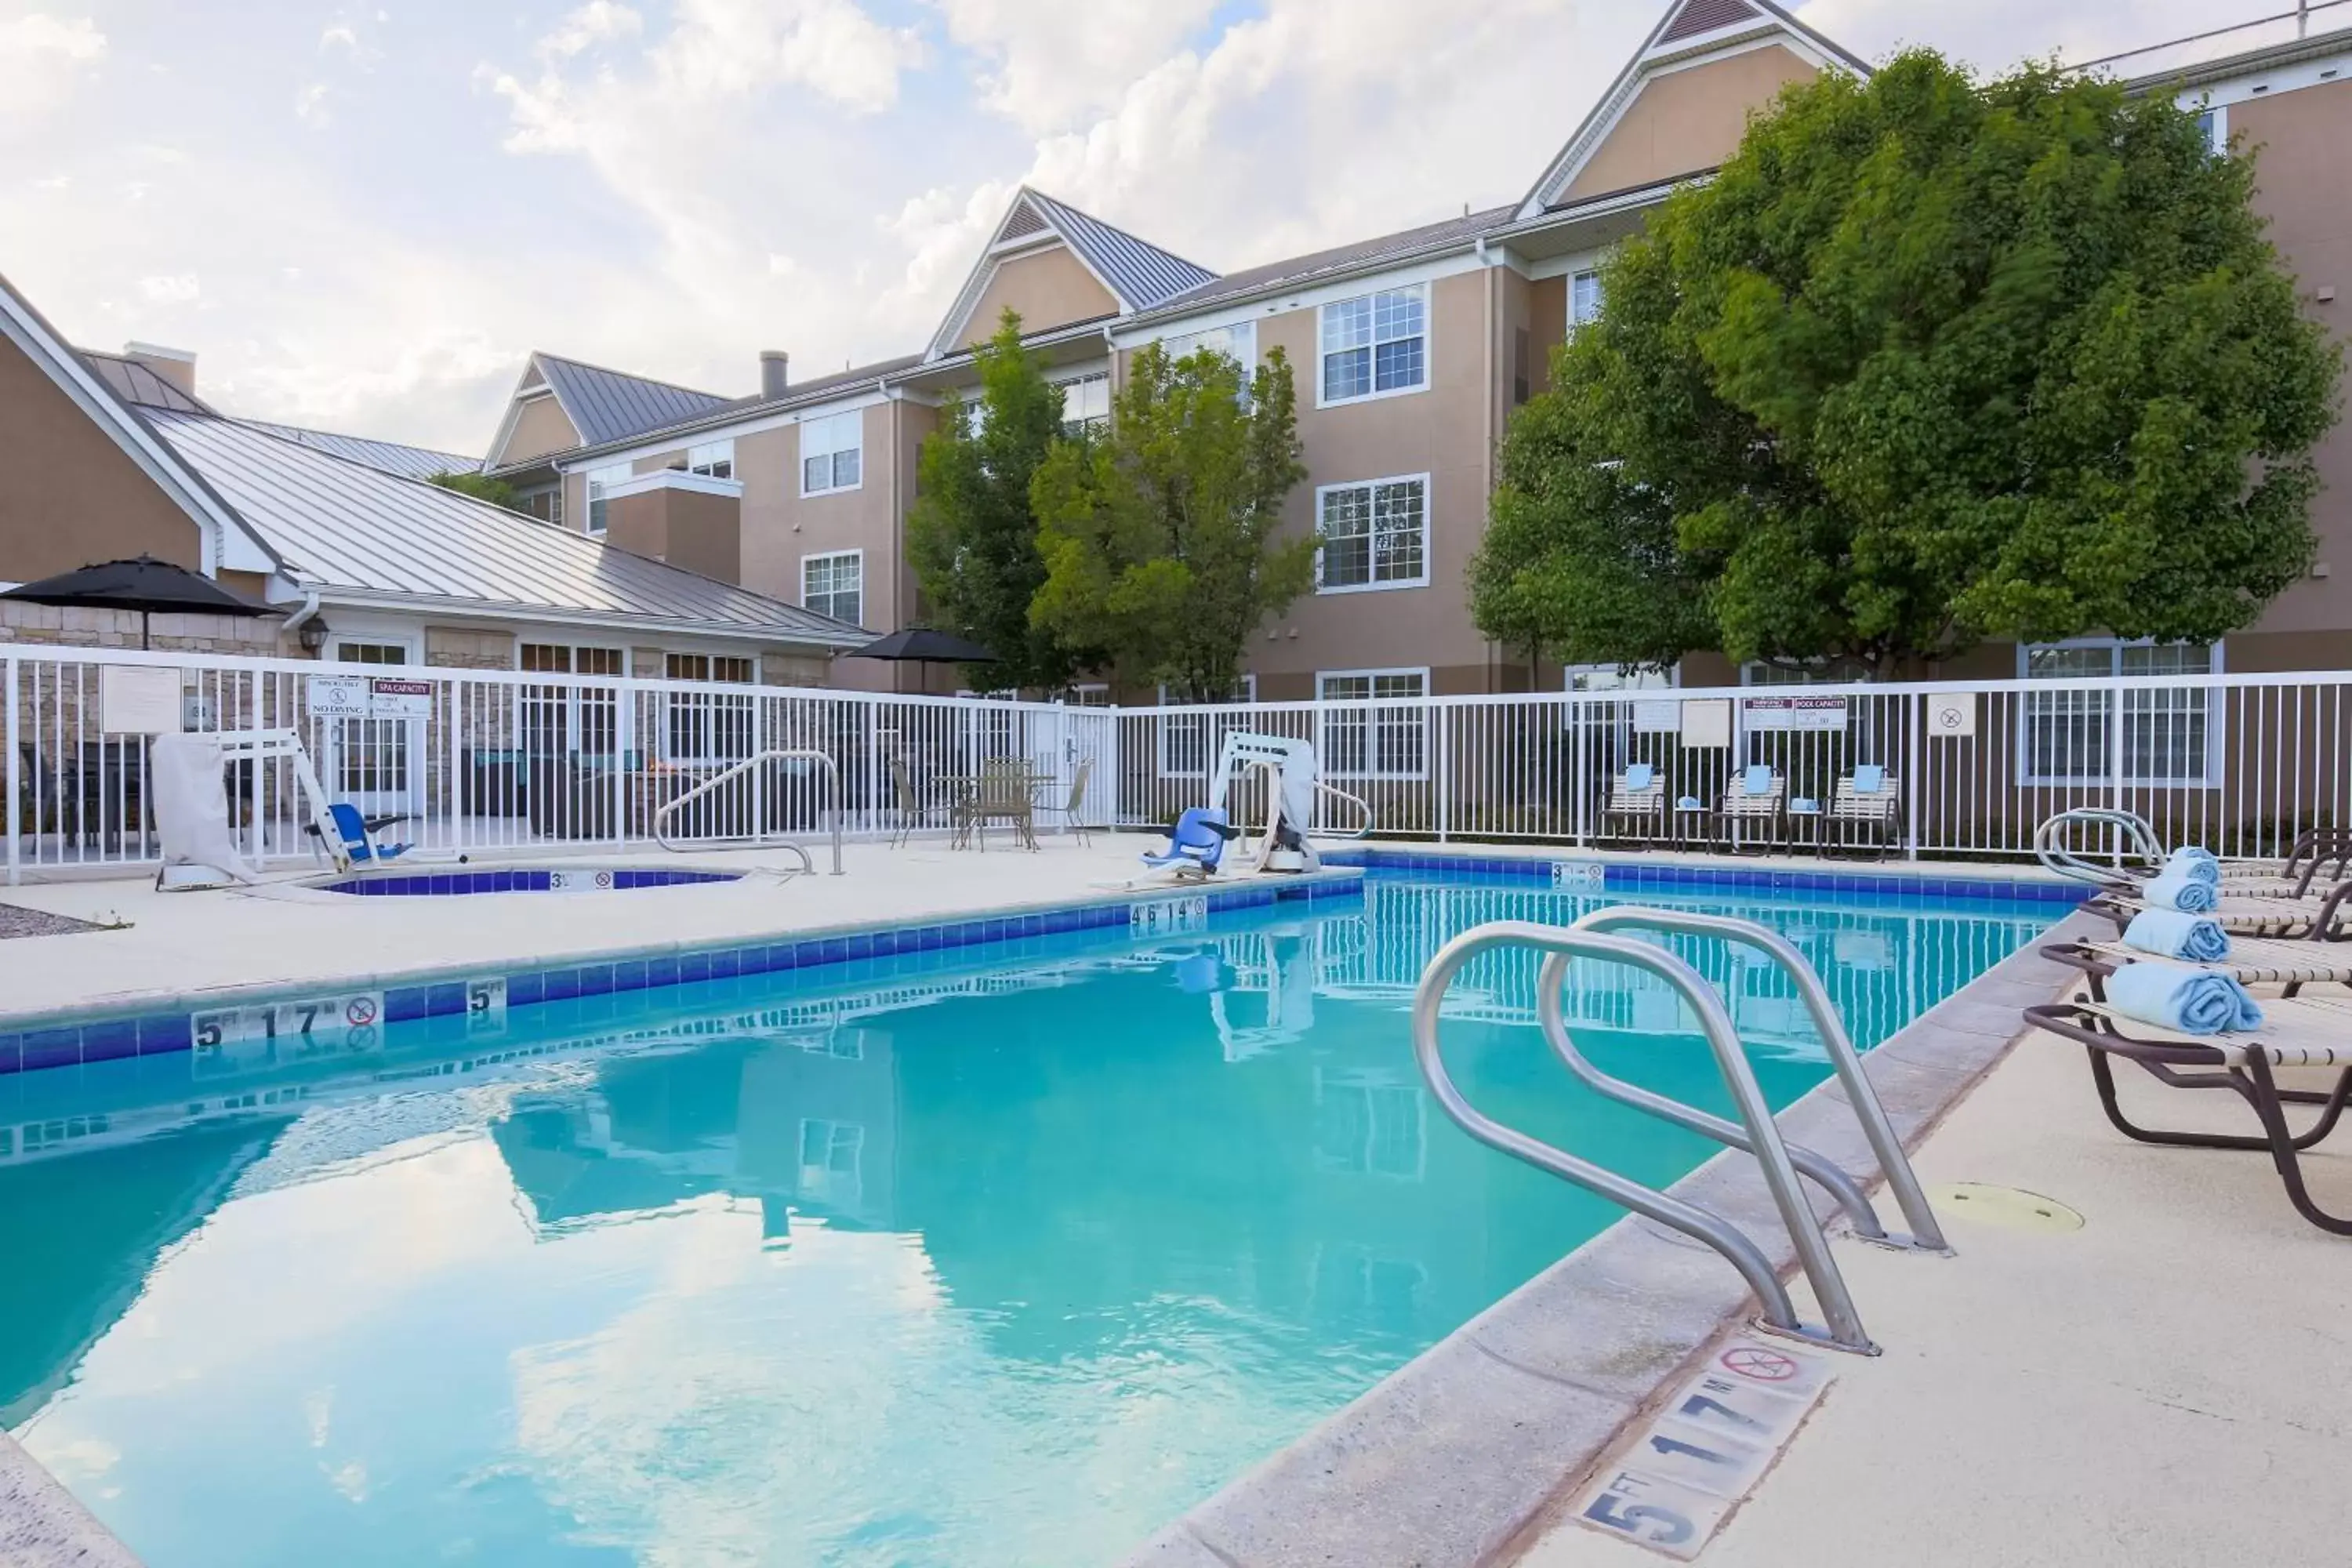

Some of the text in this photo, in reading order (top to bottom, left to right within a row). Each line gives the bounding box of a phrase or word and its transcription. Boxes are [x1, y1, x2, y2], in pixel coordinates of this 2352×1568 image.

[379, 683, 427, 693] SPA CAPACITY
[330, 706, 364, 714] DIVING
